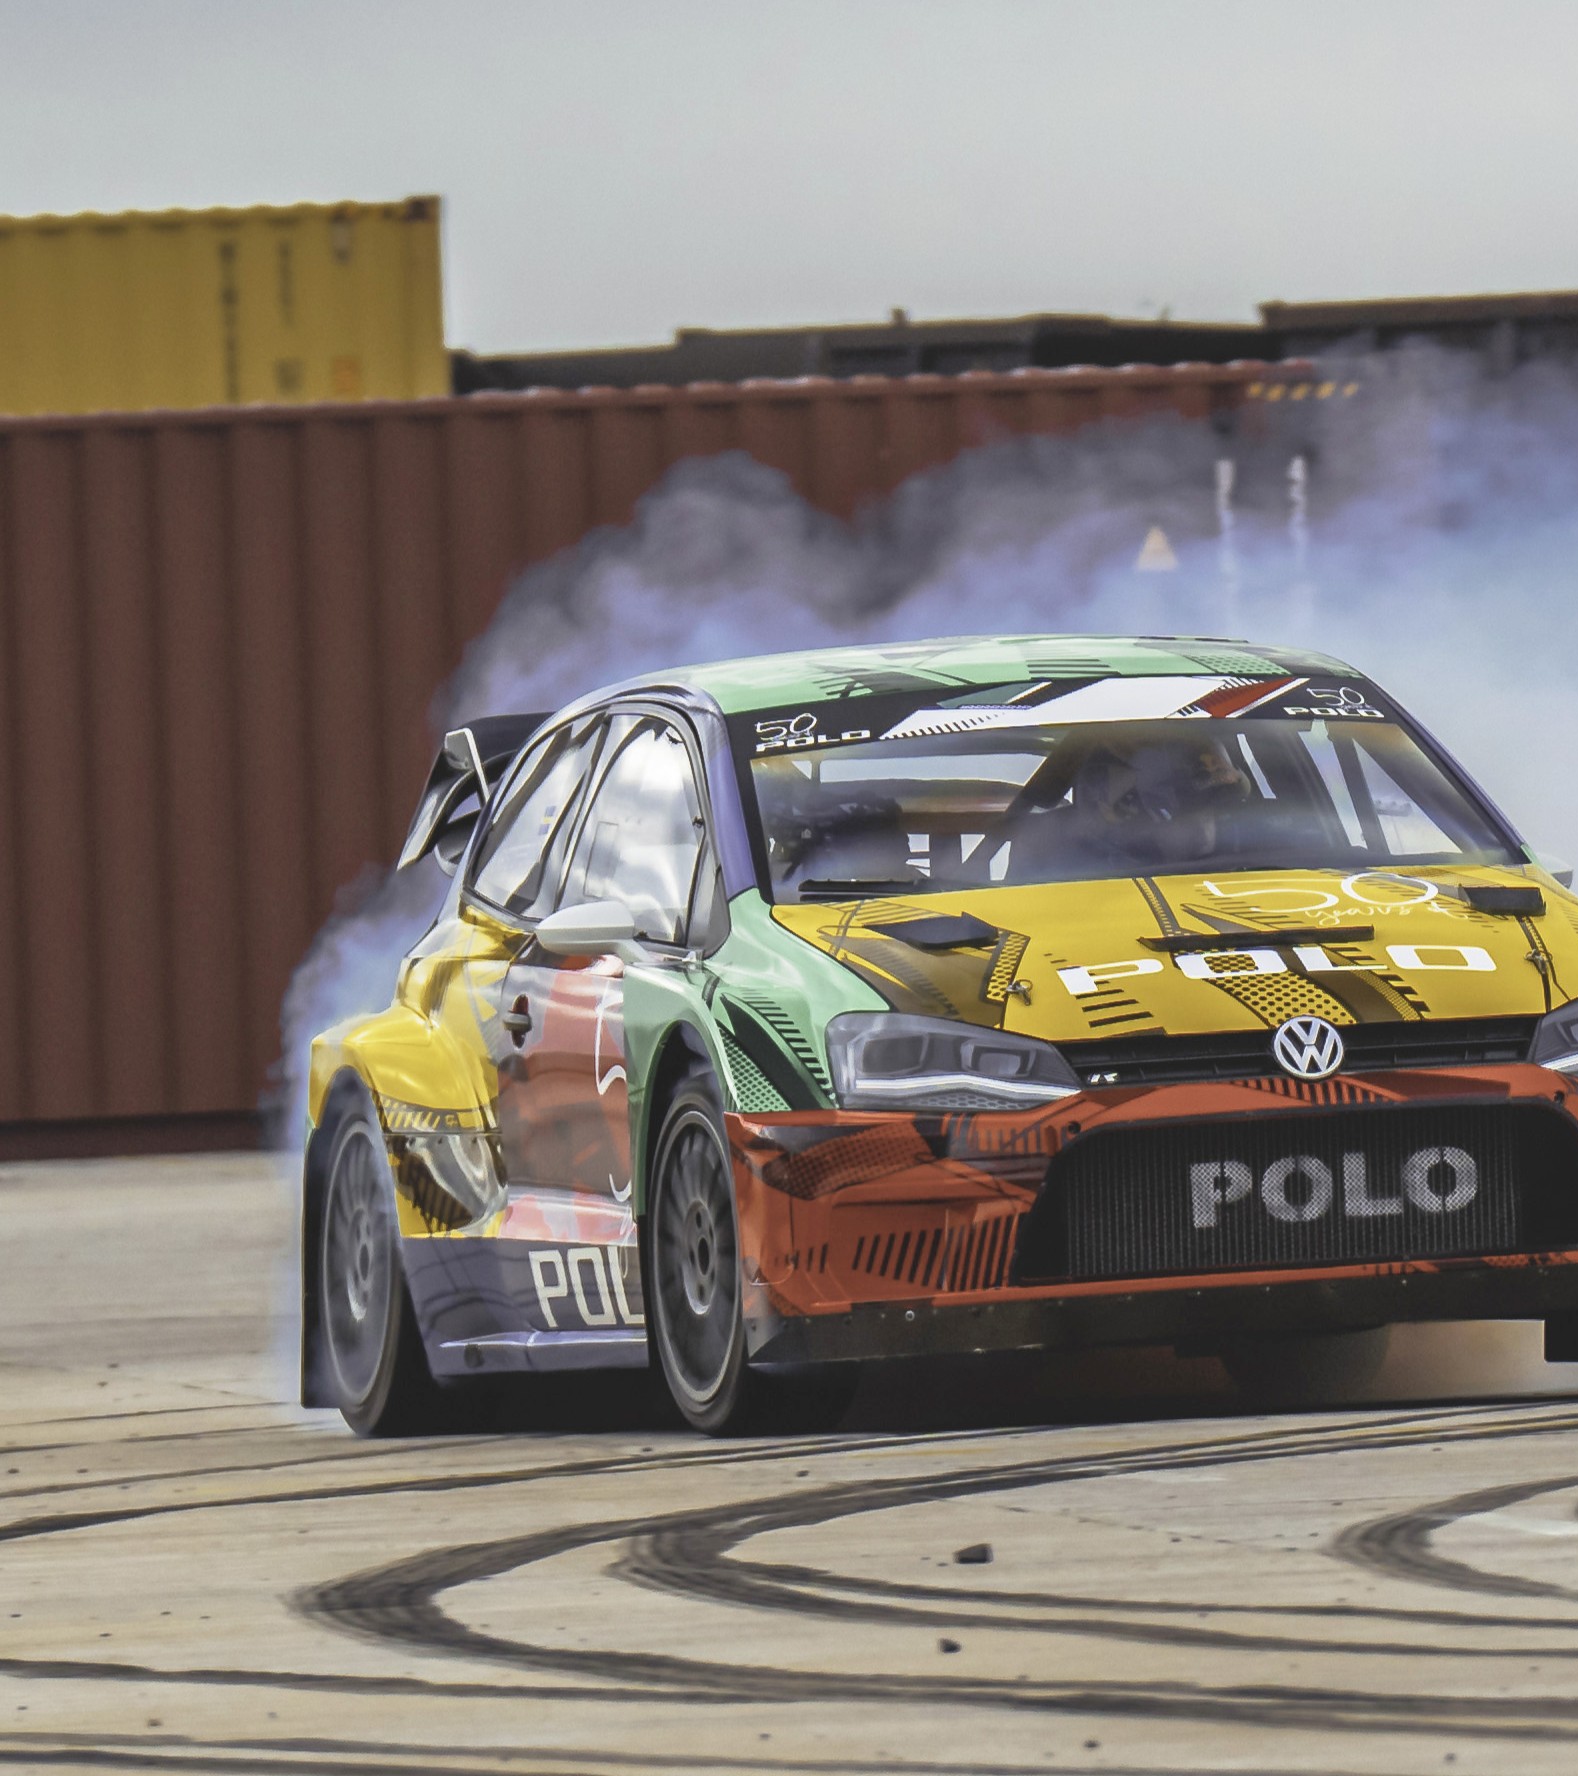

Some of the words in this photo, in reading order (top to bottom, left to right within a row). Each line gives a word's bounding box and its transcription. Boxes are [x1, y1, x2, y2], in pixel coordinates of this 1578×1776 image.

[1306, 687, 1365, 706] 50
[755, 712, 817, 740] 50
[1283, 706, 1385, 718] POLO
[756, 729, 870, 752] POLO
[1195, 872, 1438, 913] 50
[1056, 945, 1497, 995] POLO
[1190, 1146, 1478, 1228] POLO
